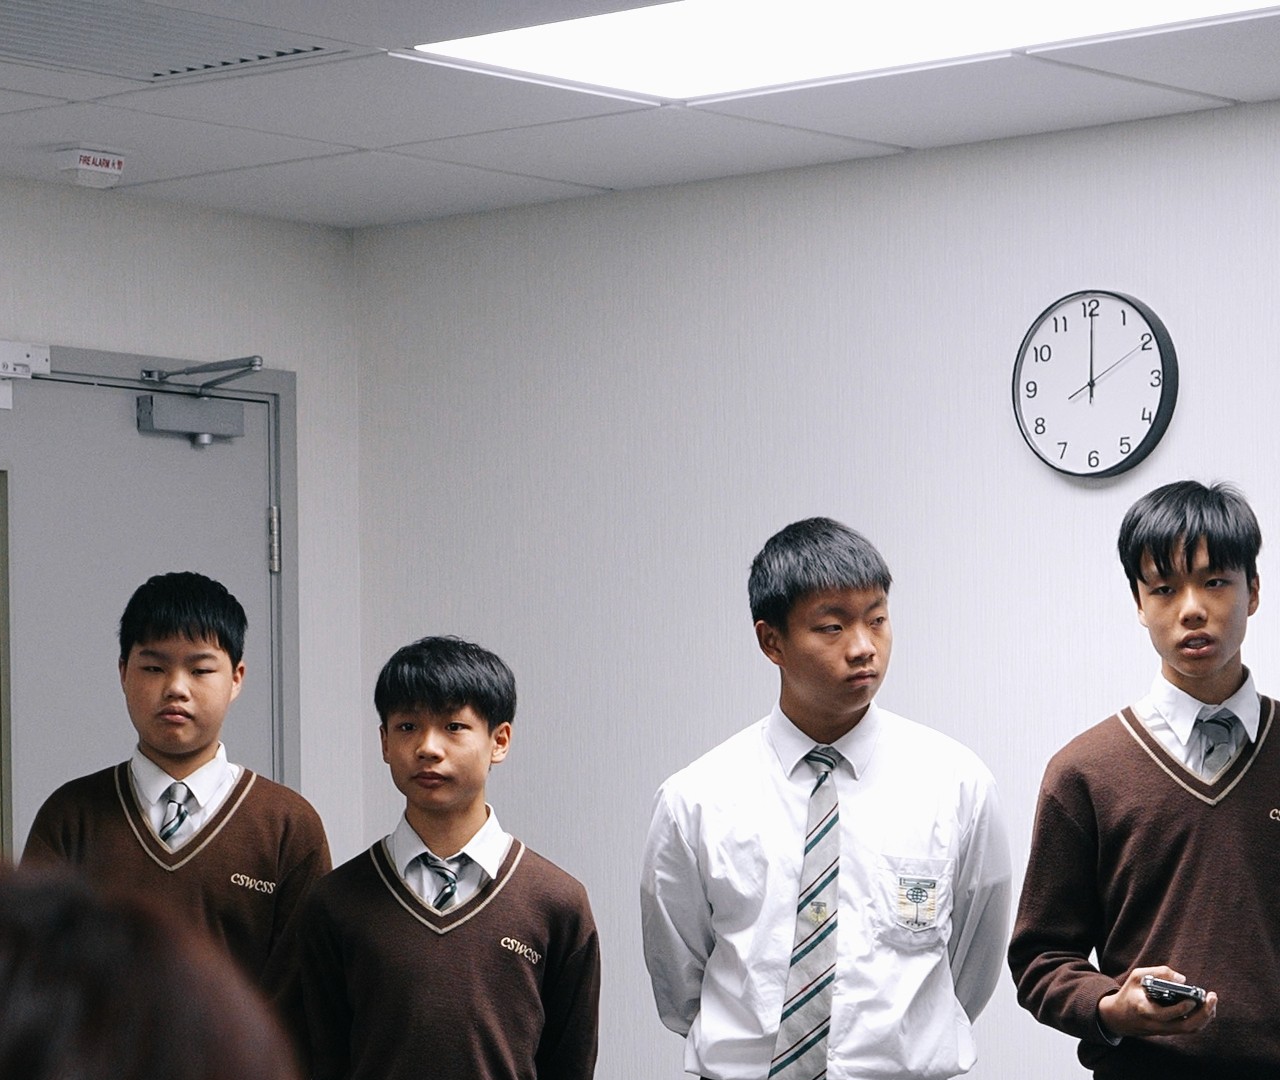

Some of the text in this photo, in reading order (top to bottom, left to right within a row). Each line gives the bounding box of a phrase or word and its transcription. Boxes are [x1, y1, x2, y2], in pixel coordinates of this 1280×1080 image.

[1081, 299, 1100, 318] 12
[1121, 309, 1126, 326] 1
[1053, 316, 1067, 333] 11
[1140, 333, 1153, 351] 2
[1033, 344, 1051, 363] 10
[1150, 369, 1162, 388] 3
[1025, 380, 1038, 399] 9
[1141, 407, 1152, 424] 4
[1034, 417, 1046, 435] 8
[1057, 441, 1068, 459] 7
[1119, 436, 1131, 455] 5
[1087, 450, 1099, 468] 6
[230, 872, 276, 894] CSWCSS
